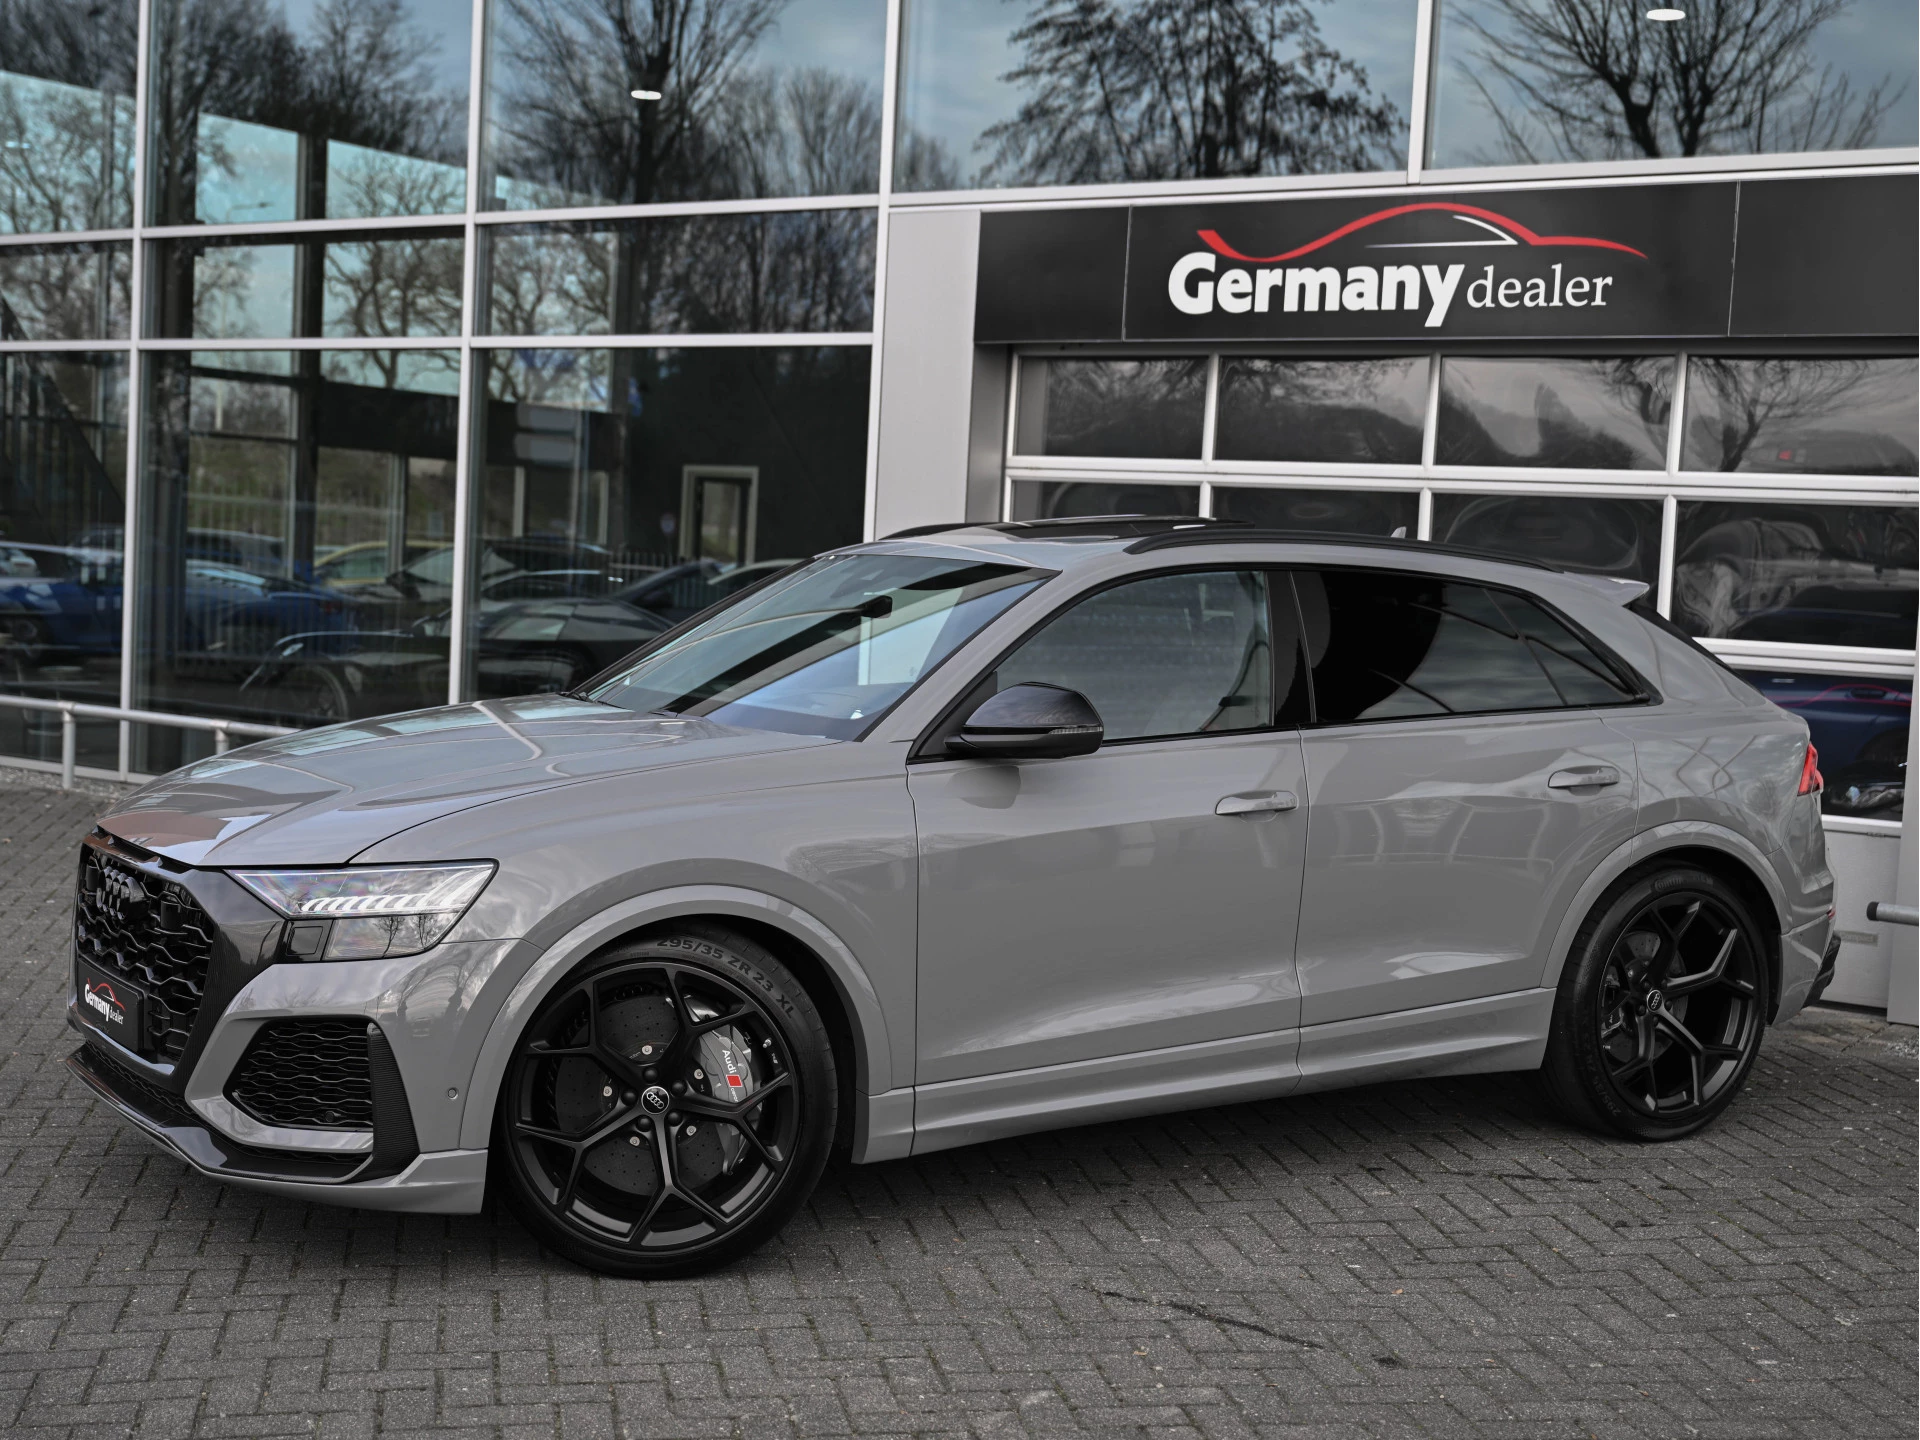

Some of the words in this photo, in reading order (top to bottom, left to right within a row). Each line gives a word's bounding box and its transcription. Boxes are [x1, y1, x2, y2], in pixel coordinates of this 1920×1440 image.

[1168, 251, 1465, 327] Germany
[1467, 262, 1613, 308] dealer
[84, 983, 110, 1022] Germany
[109, 1006, 124, 1025] dealer
[656, 937, 724, 960] 295/35
[727, 955, 751, 975] ZR
[752, 972, 774, 992] 23
[775, 994, 795, 1019] XL
[722, 1049, 737, 1074] Audi
